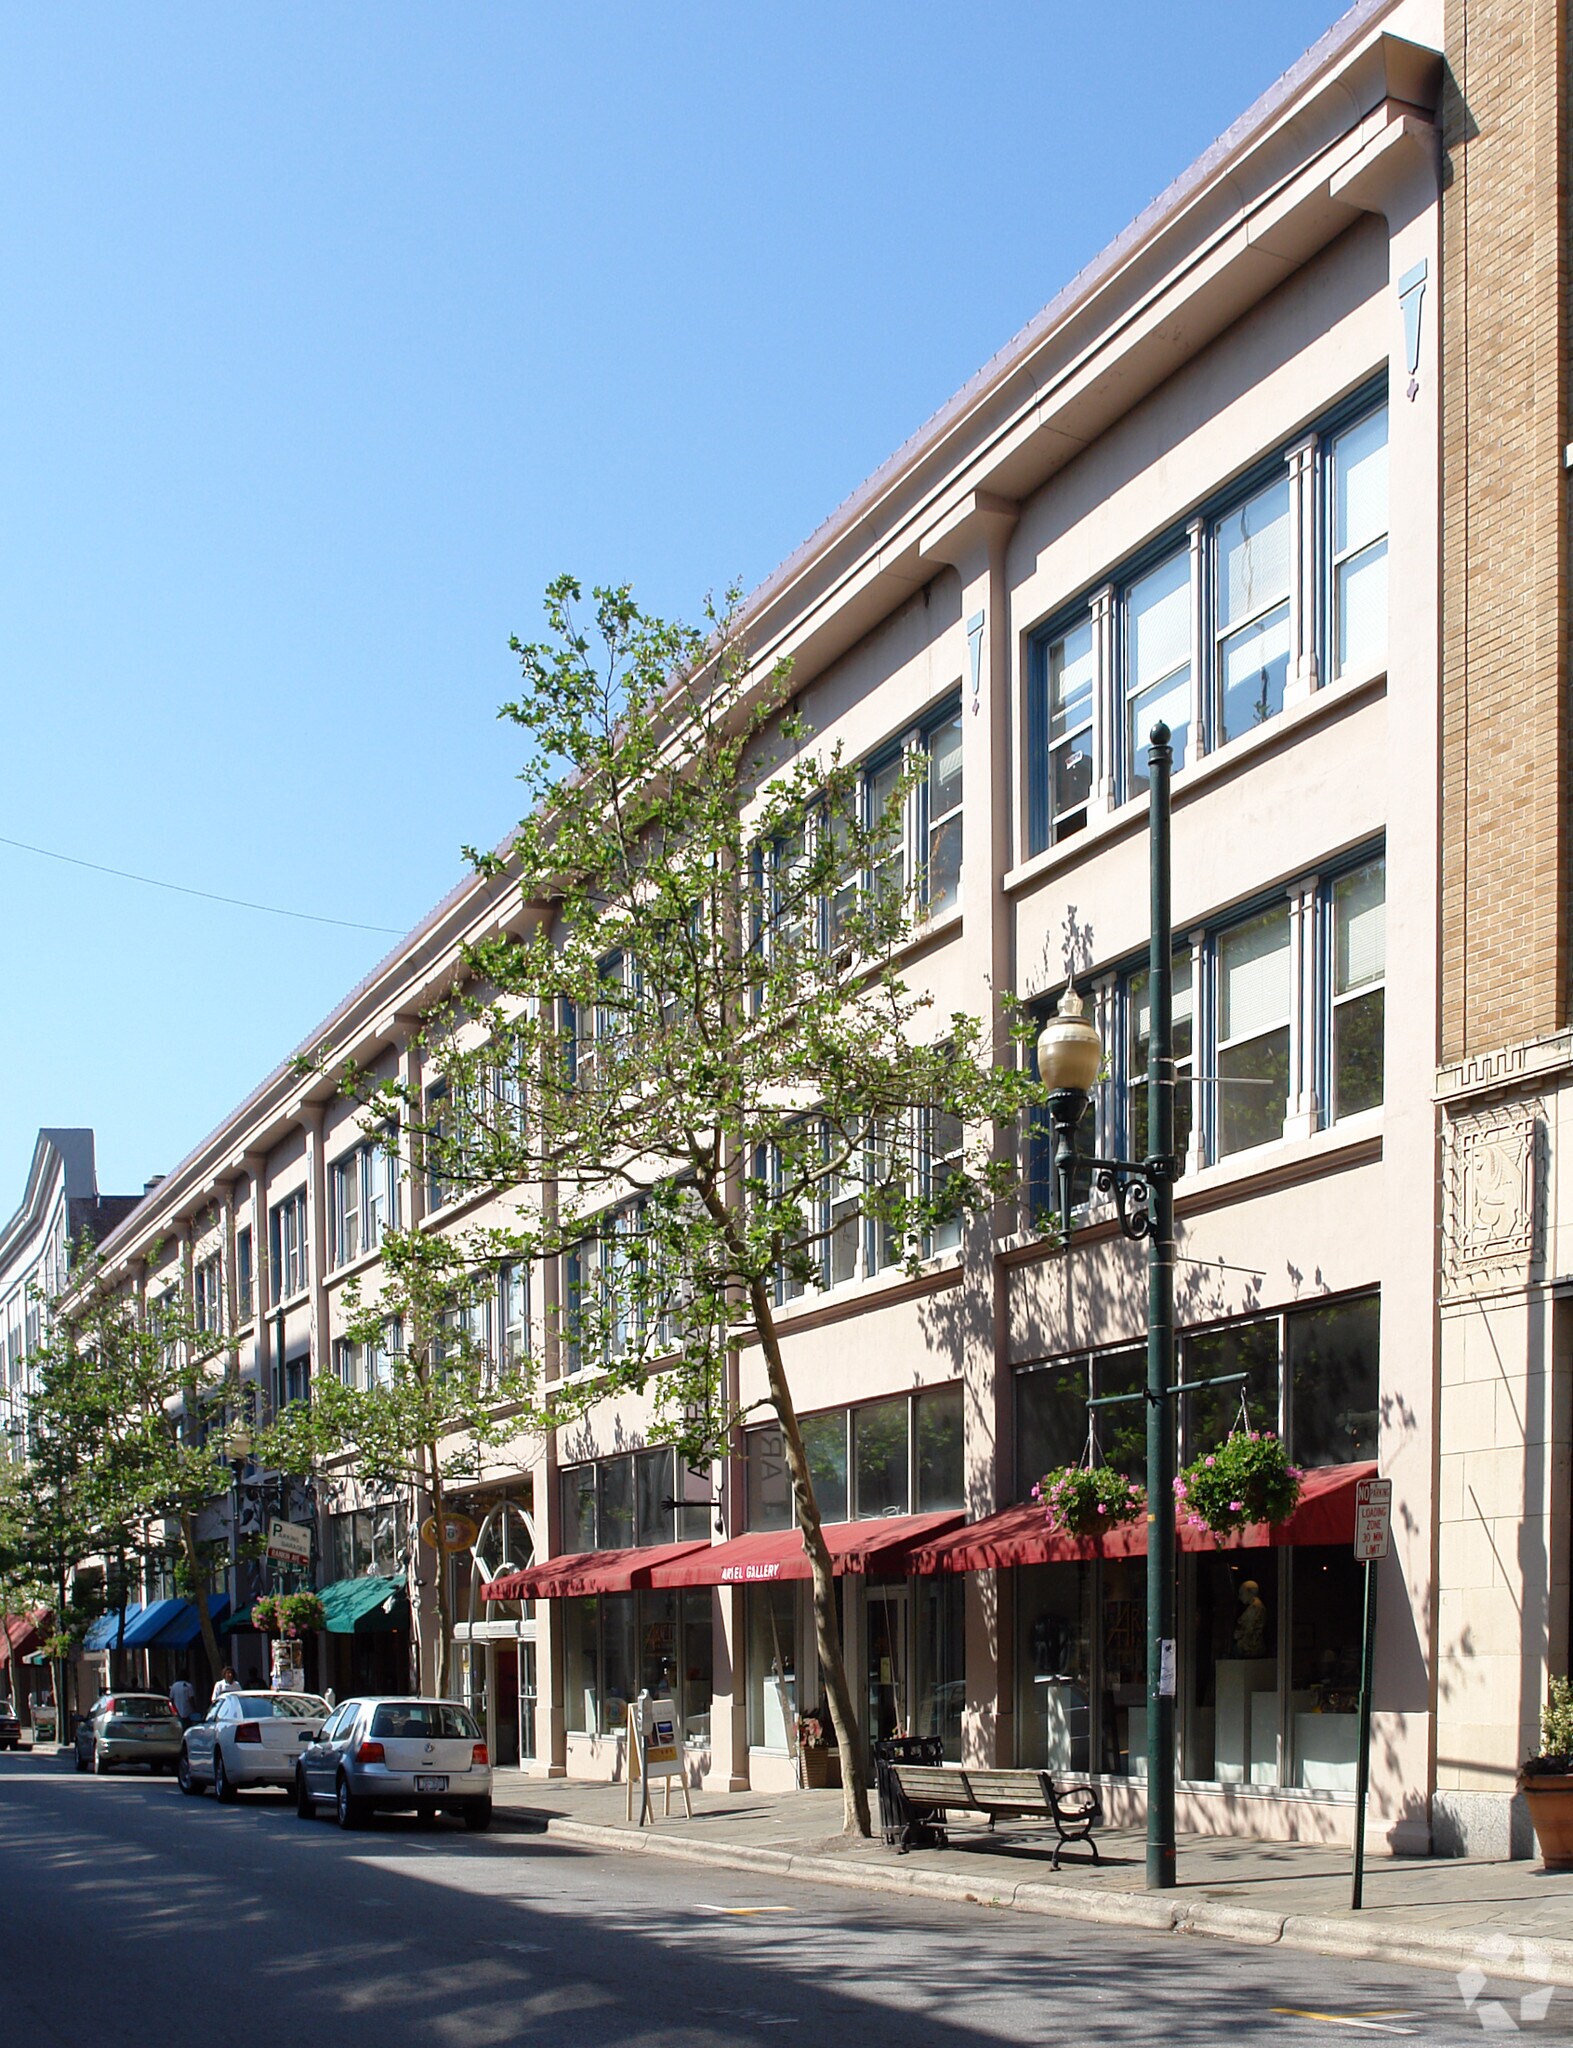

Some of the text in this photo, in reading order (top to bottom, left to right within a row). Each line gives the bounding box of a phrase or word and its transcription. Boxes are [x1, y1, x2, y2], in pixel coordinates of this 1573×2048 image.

[1359, 1485, 1390, 1501] NO PARKING
[1361, 1506, 1387, 1518] LOADING
[1366, 1520, 1382, 1531] ZONE
[1362, 1531, 1384, 1543] 30 MIN
[1365, 1544, 1380, 1555] LIMIT
[721, 1563, 780, 1580] ARIEL GALLERY
